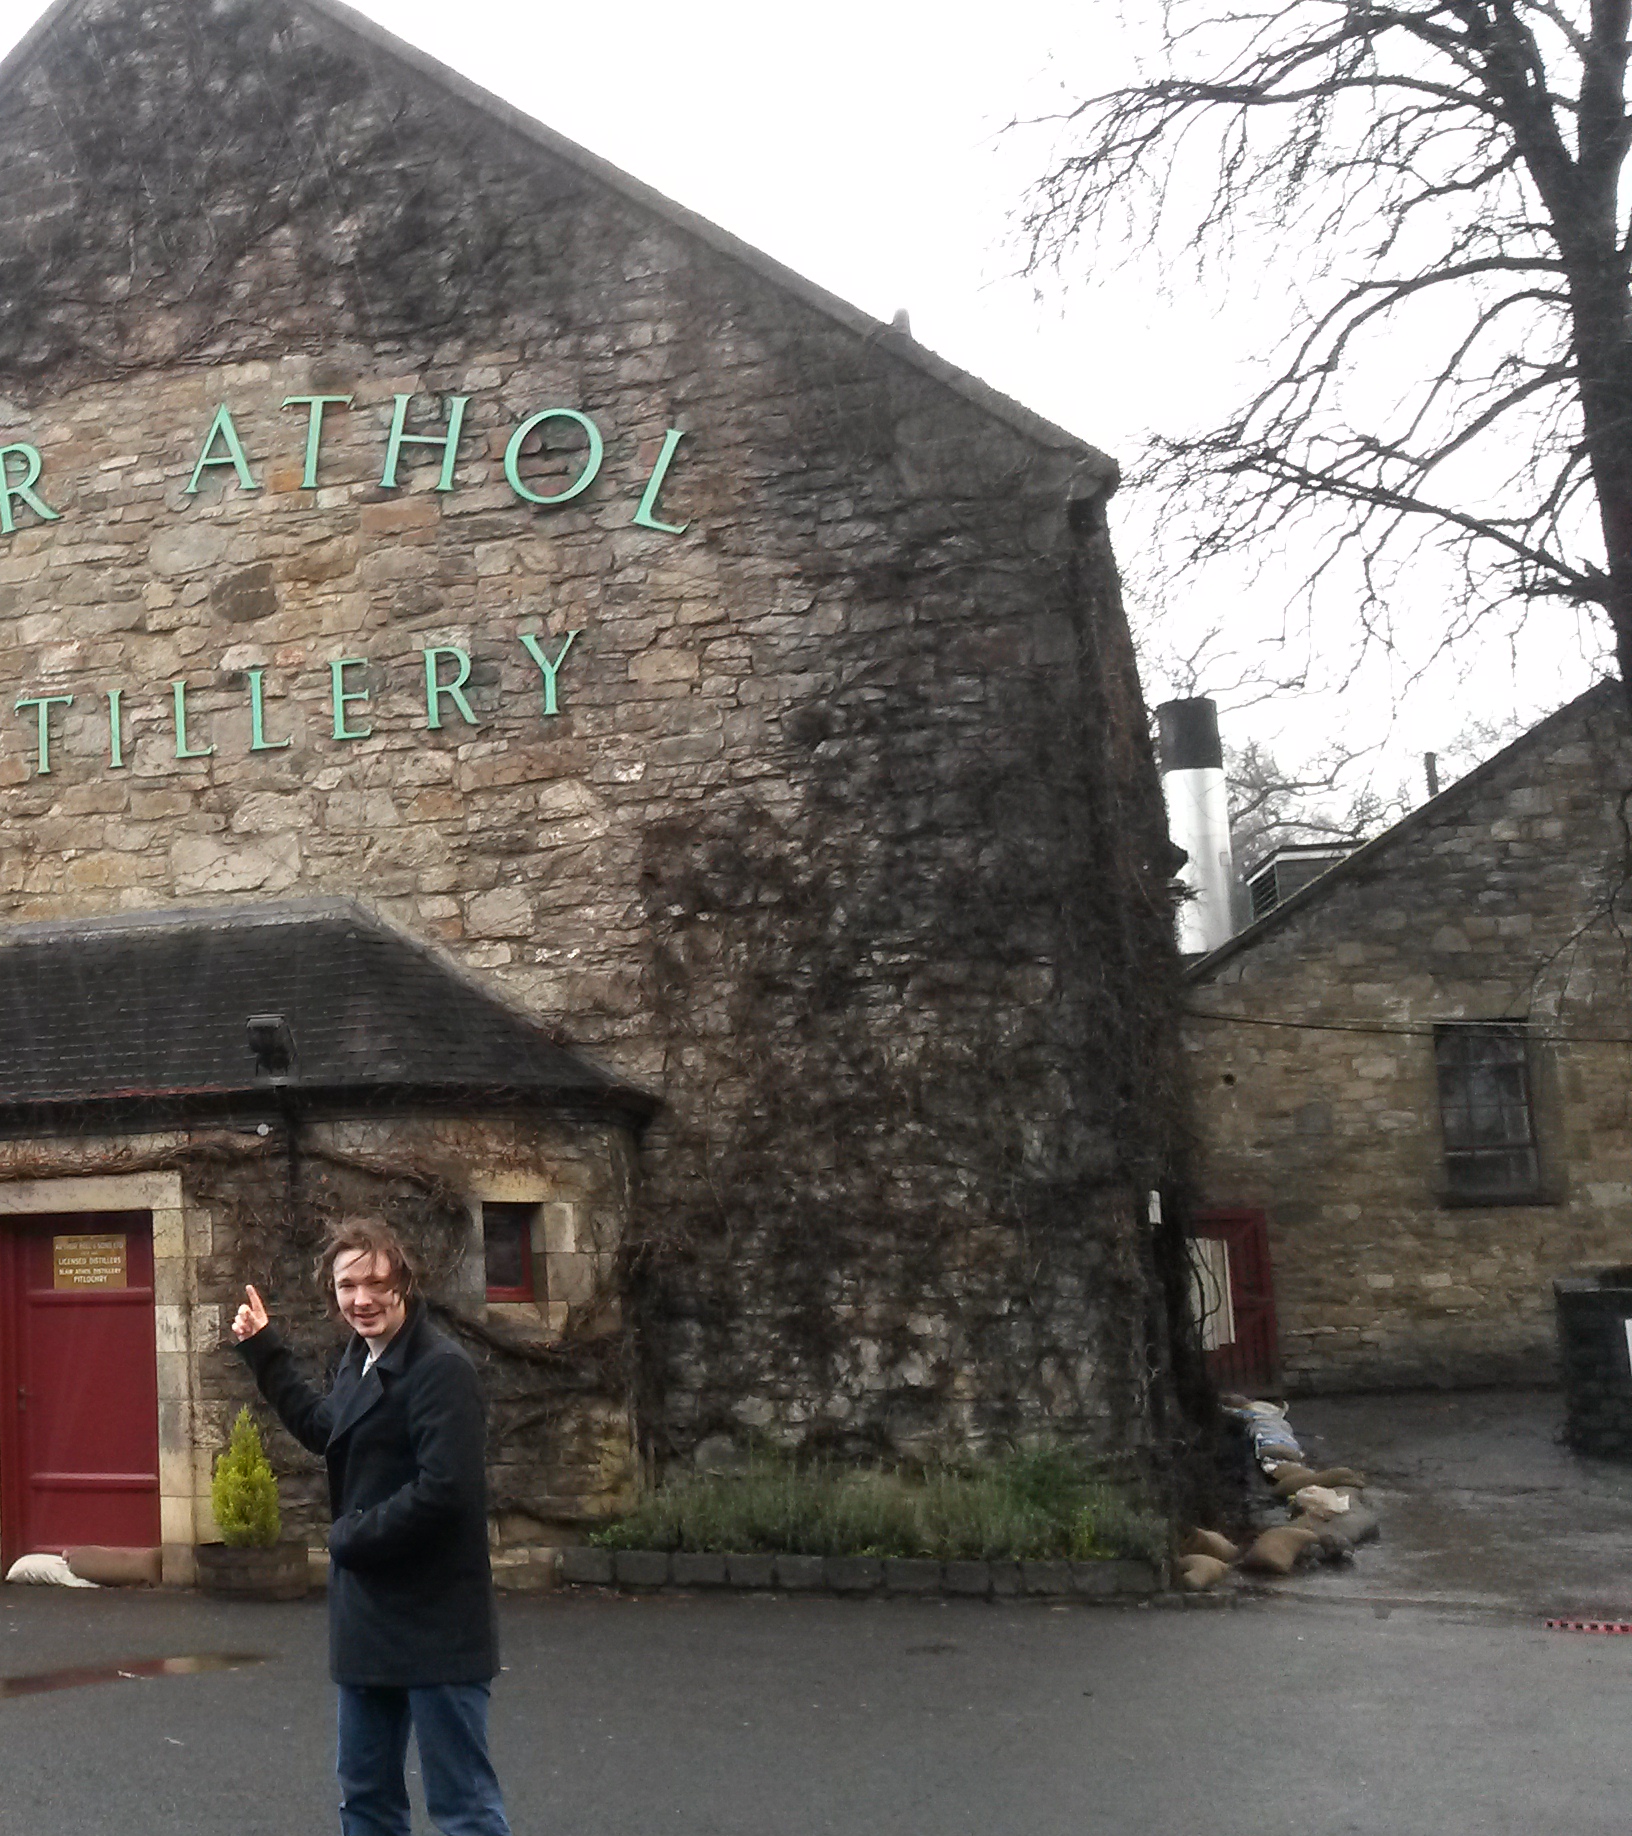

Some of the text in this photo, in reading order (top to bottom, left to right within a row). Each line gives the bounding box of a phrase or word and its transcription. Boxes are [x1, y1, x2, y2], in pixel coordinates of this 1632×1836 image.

[184, 394, 688, 536] ATHOL
[58, 1256, 121, 1265] LICENSED DISTILLERS
